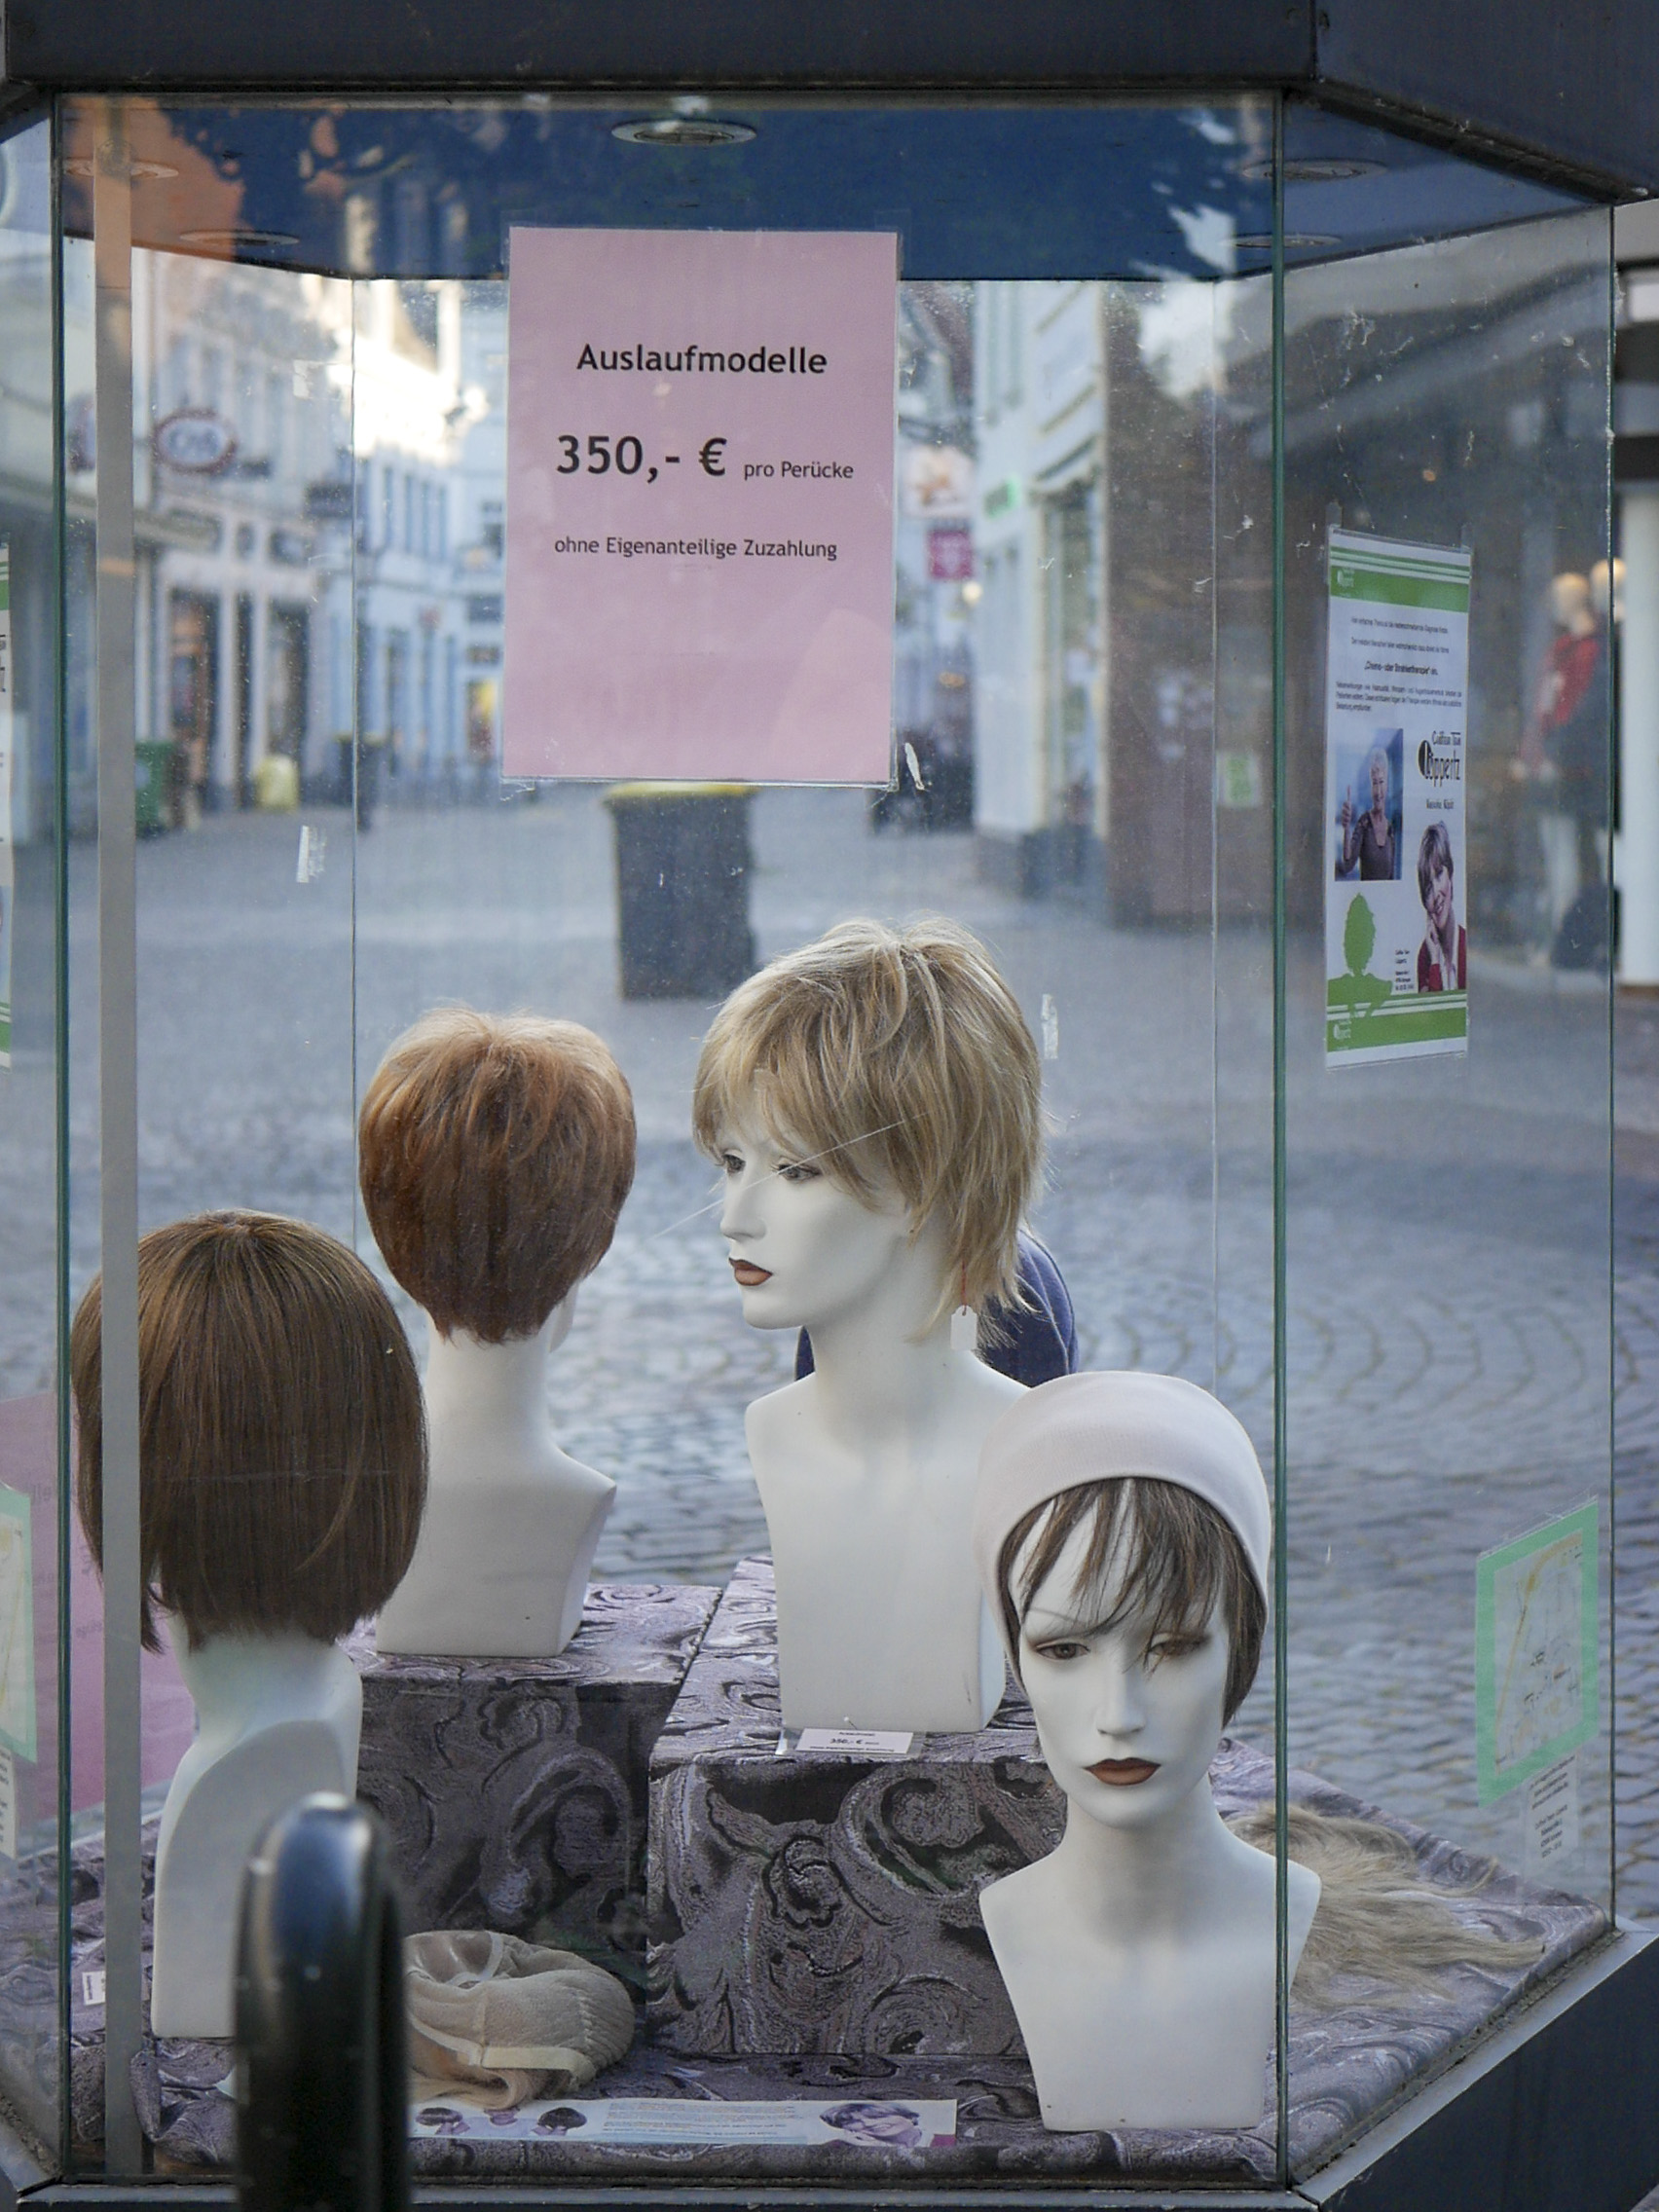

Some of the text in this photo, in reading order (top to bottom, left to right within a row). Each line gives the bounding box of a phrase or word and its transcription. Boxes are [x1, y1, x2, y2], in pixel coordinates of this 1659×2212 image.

[576, 343, 828, 375] Auslaufmodelle
[556, 434, 855, 484] 350,- € pro Perücke
[554, 535, 837, 562] ohne Eigenanteilige Zuzahlung
[1418, 739, 1460, 788] Lippertz
